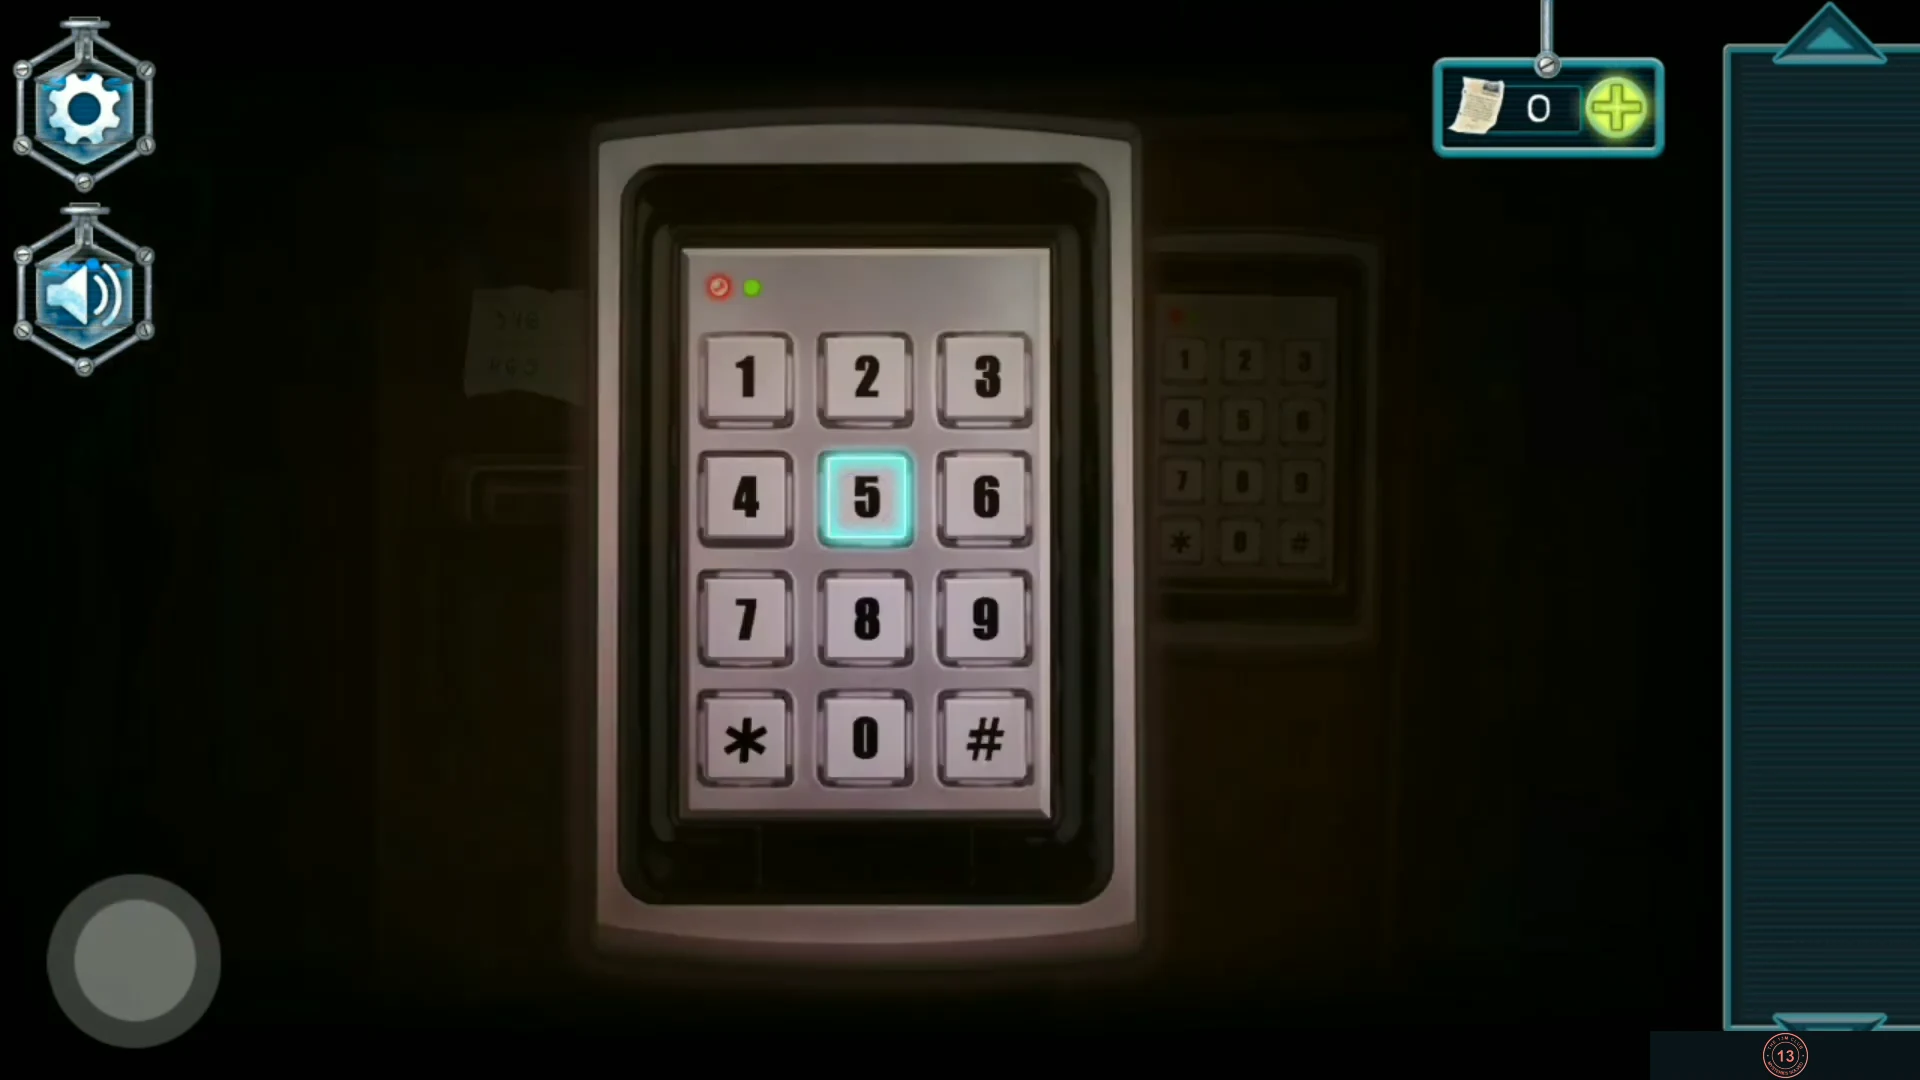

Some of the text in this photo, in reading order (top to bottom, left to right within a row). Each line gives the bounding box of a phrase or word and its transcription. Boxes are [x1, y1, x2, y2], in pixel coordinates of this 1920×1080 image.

[1527, 93, 1551, 123] 0
[1180, 349, 1311, 373] 1 2 3
[736, 356, 1001, 398] 1 2 3
[1176, 409, 1190, 430] 4
[1236, 409, 1250, 431] 5
[1177, 470, 1188, 491] 7
[1295, 471, 1308, 493] 9
[733, 476, 1000, 518] 4 5 6
[1233, 531, 1247, 553] 0
[735, 597, 999, 640] 7 8 9
[853, 717, 878, 760] 0
[967, 717, 1005, 761] #
